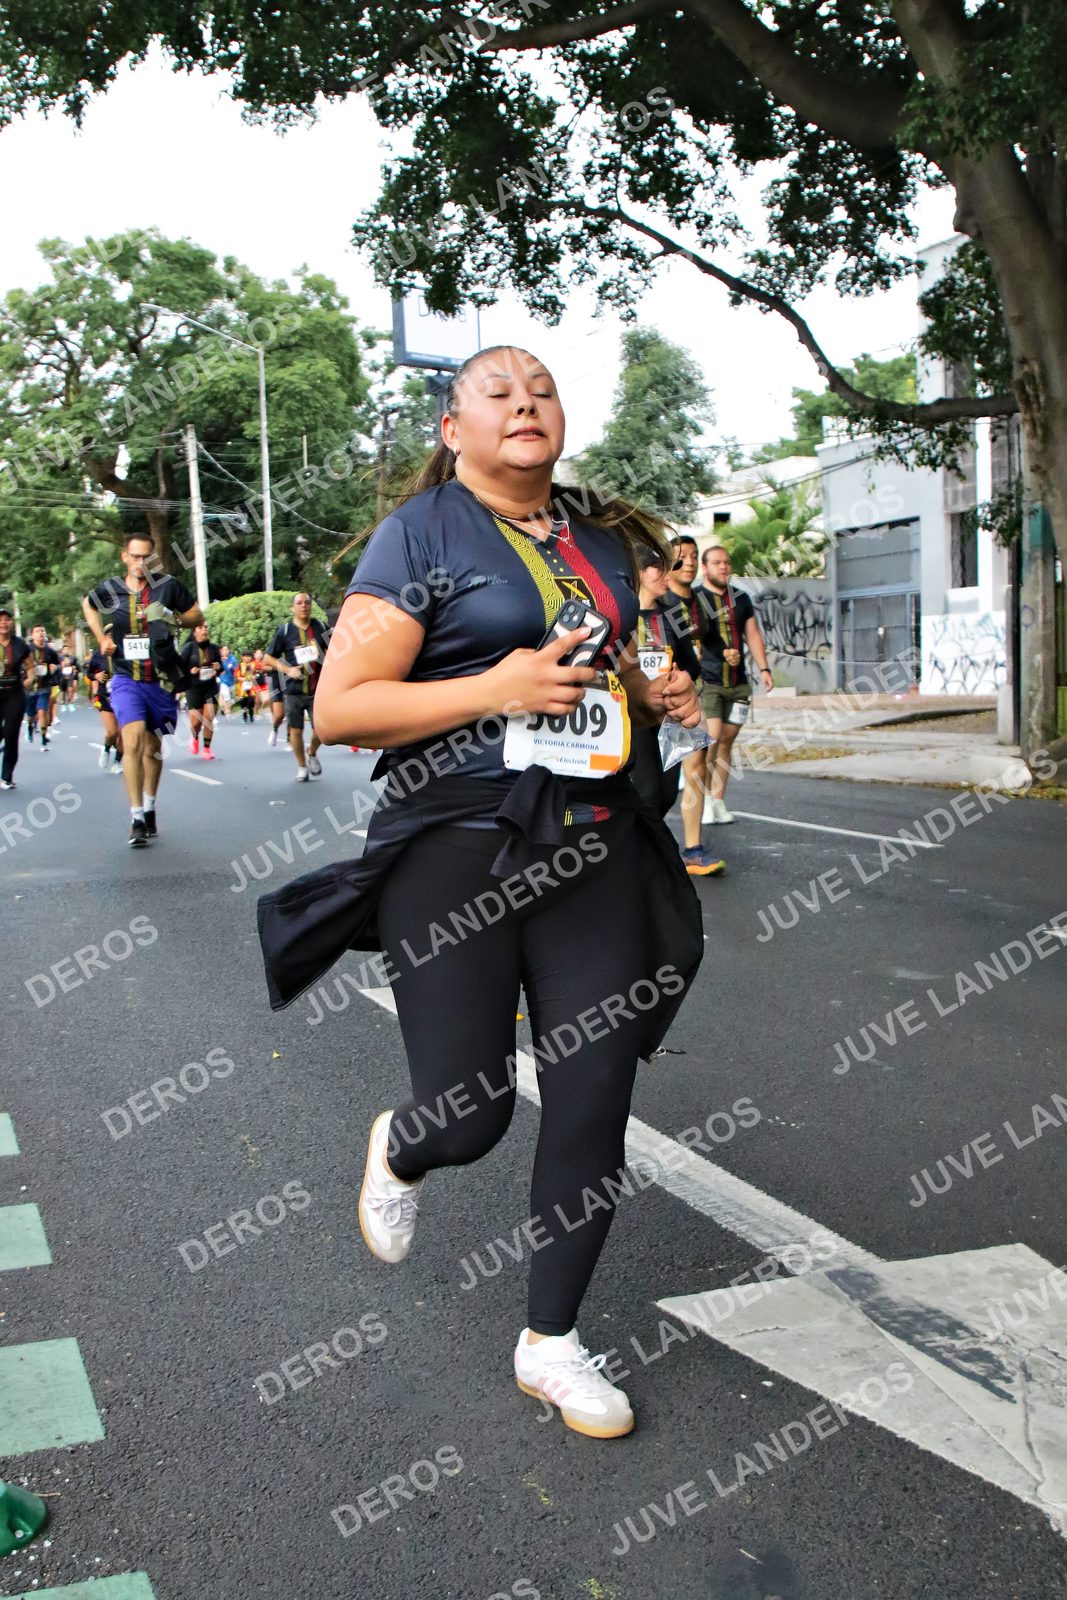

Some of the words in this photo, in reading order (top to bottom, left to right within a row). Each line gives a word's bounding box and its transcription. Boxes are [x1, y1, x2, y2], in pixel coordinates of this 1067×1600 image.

[643, 655, 663, 668] 687
[533, 738, 565, 748] VICTORIA
[566, 741, 600, 751] CARMONA
